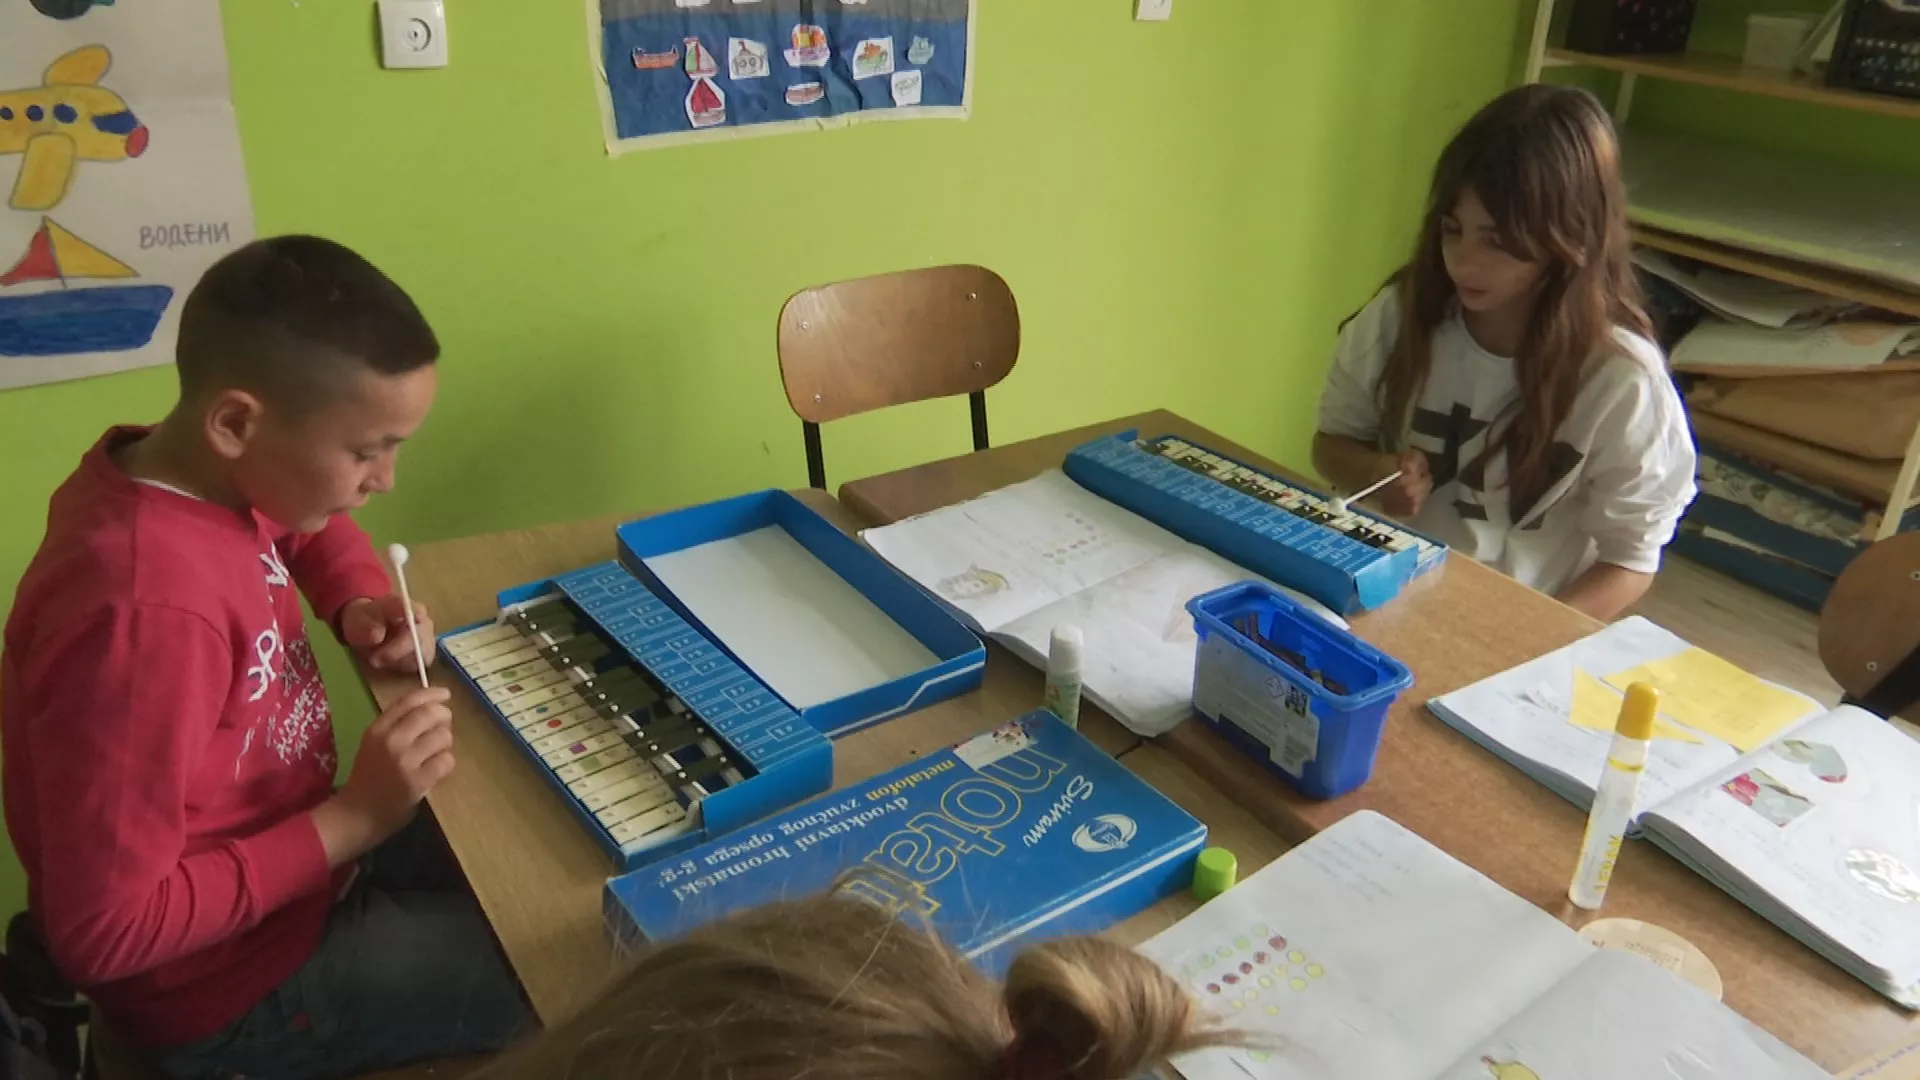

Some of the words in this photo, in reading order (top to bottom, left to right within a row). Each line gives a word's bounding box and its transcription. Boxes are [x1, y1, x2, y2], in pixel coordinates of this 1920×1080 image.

[138, 220, 231, 252] ВОДЕНИ
[865, 758, 956, 802] metalofon
[778, 798, 862, 836] zvučnog
[794, 797, 909, 852] dvooktavni
[1022, 774, 1095, 848] Sviram
[704, 831, 775, 866] opsega
[671, 845, 793, 902] hromatski
